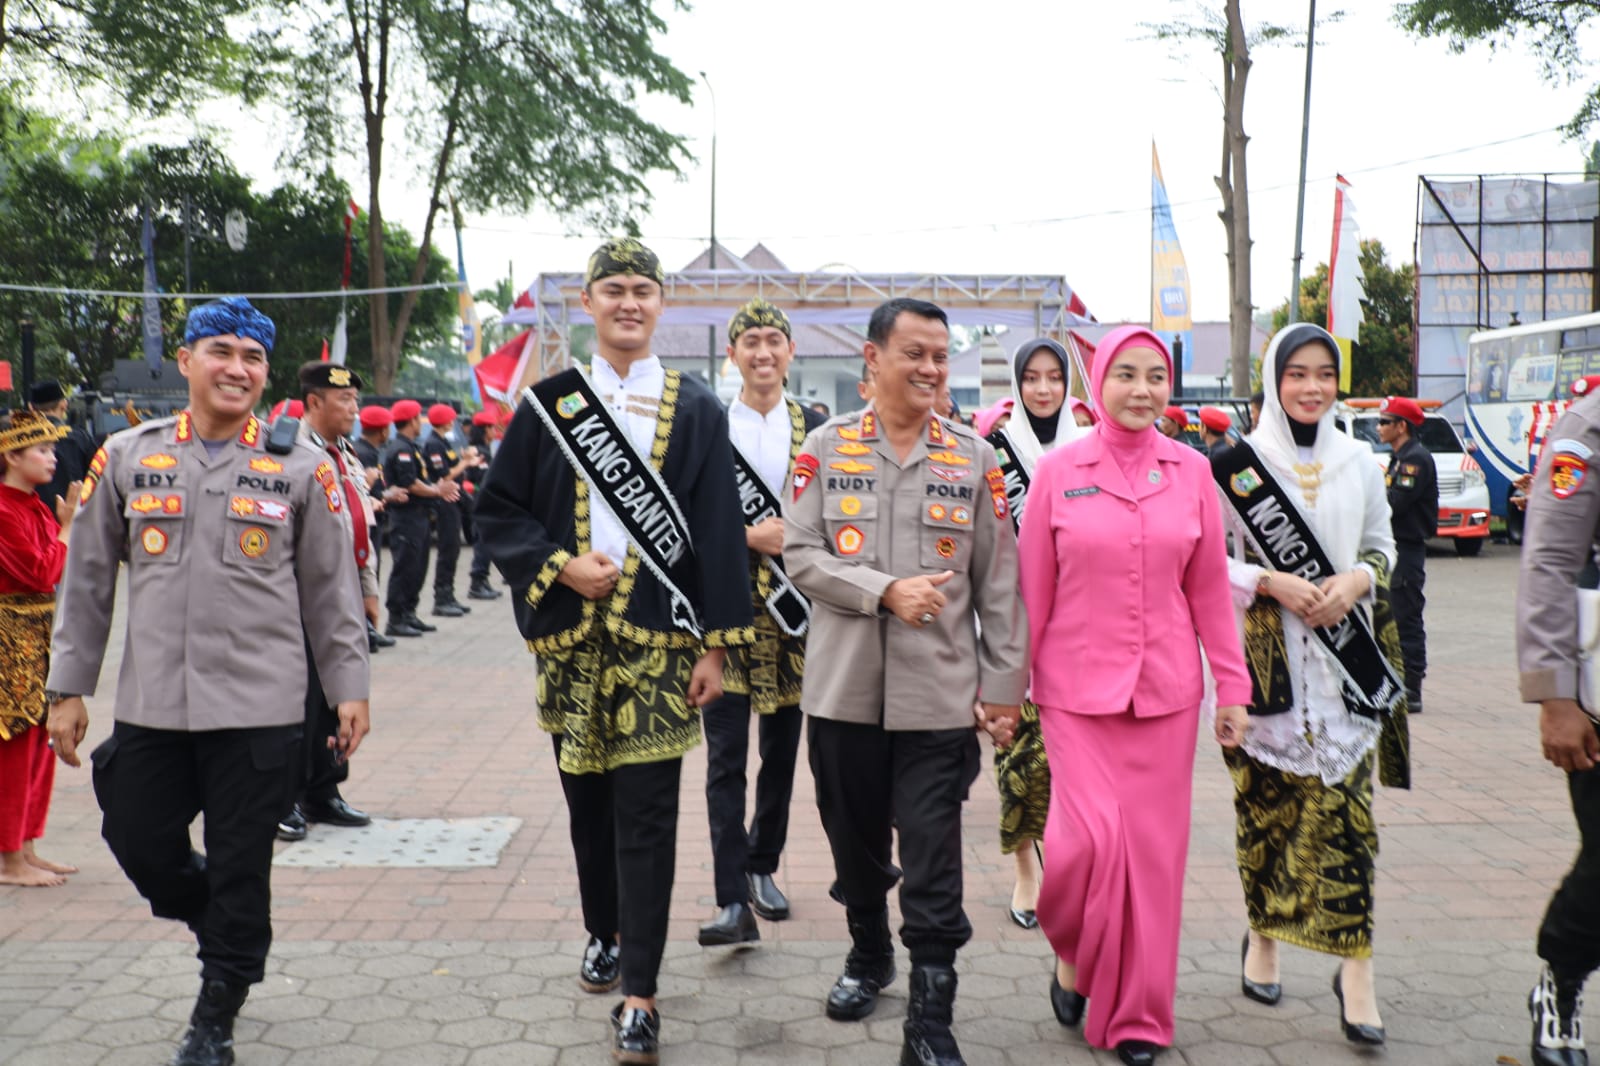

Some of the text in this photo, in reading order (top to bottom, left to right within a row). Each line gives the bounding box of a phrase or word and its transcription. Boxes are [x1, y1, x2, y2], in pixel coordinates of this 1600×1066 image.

[134, 473, 178, 487] EDY
[237, 475, 291, 494] POLRI
[827, 477, 877, 491] RUDY
[570, 414, 687, 568] KANG BANTEN
[926, 483, 973, 500] POLRI
[1004, 469, 1026, 529] NON
[1247, 494, 1309, 566] NONG
